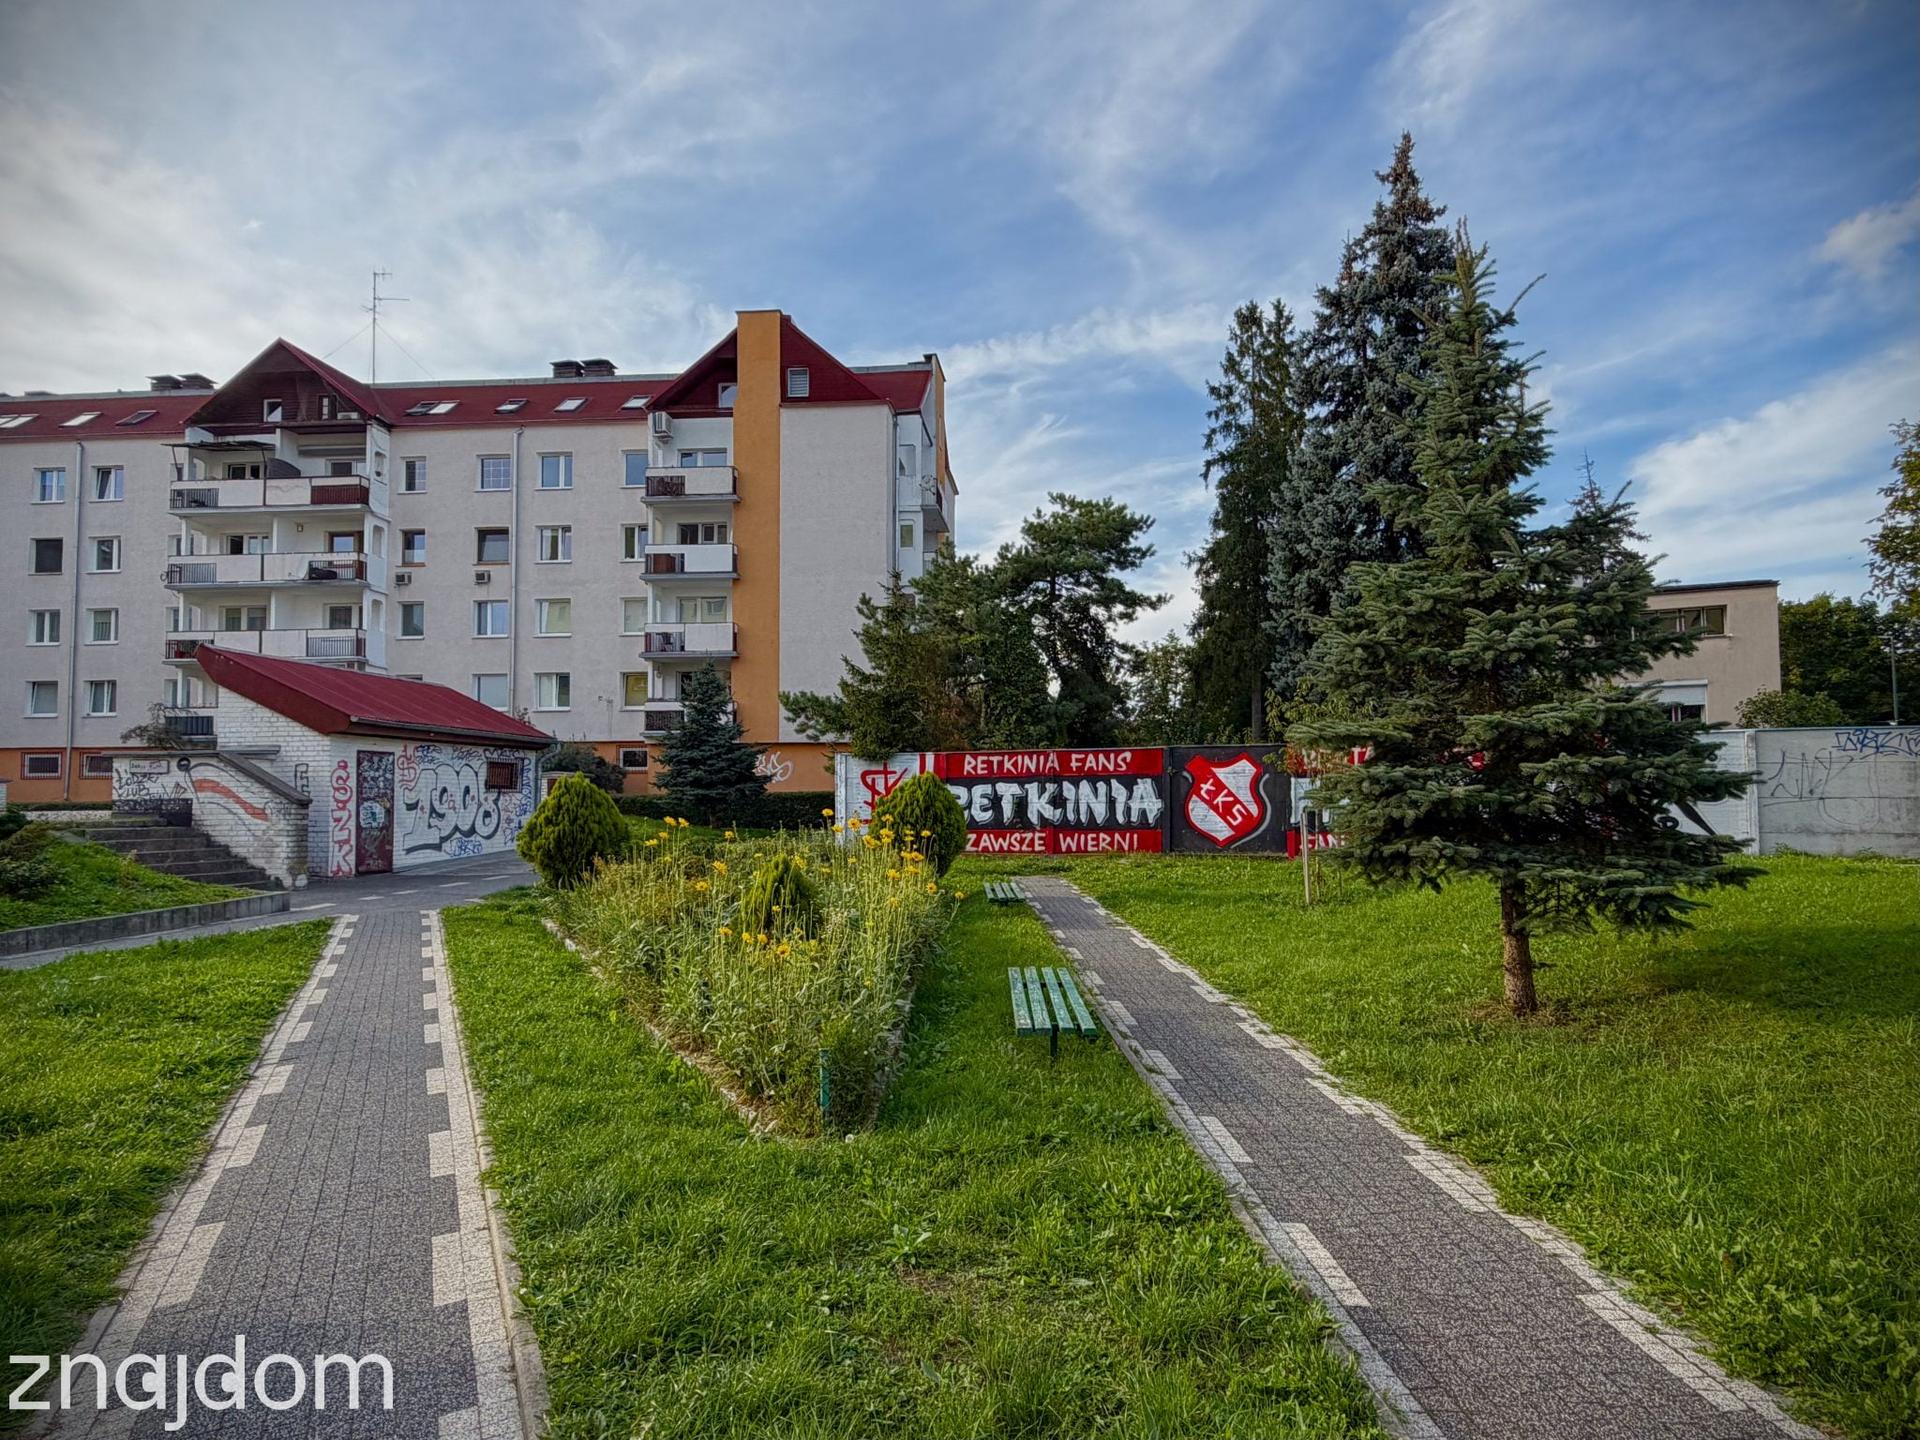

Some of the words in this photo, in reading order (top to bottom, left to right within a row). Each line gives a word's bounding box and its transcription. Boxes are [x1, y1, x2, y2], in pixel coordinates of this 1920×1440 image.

[963, 752, 1059, 775] RETKINIA
[1070, 751, 1132, 772] FANS
[402, 763, 501, 855] 1908
[1200, 778, 1248, 827] ŁKS
[965, 832, 1046, 851] ZAWSZE
[1059, 832, 1138, 851] WIERNI
